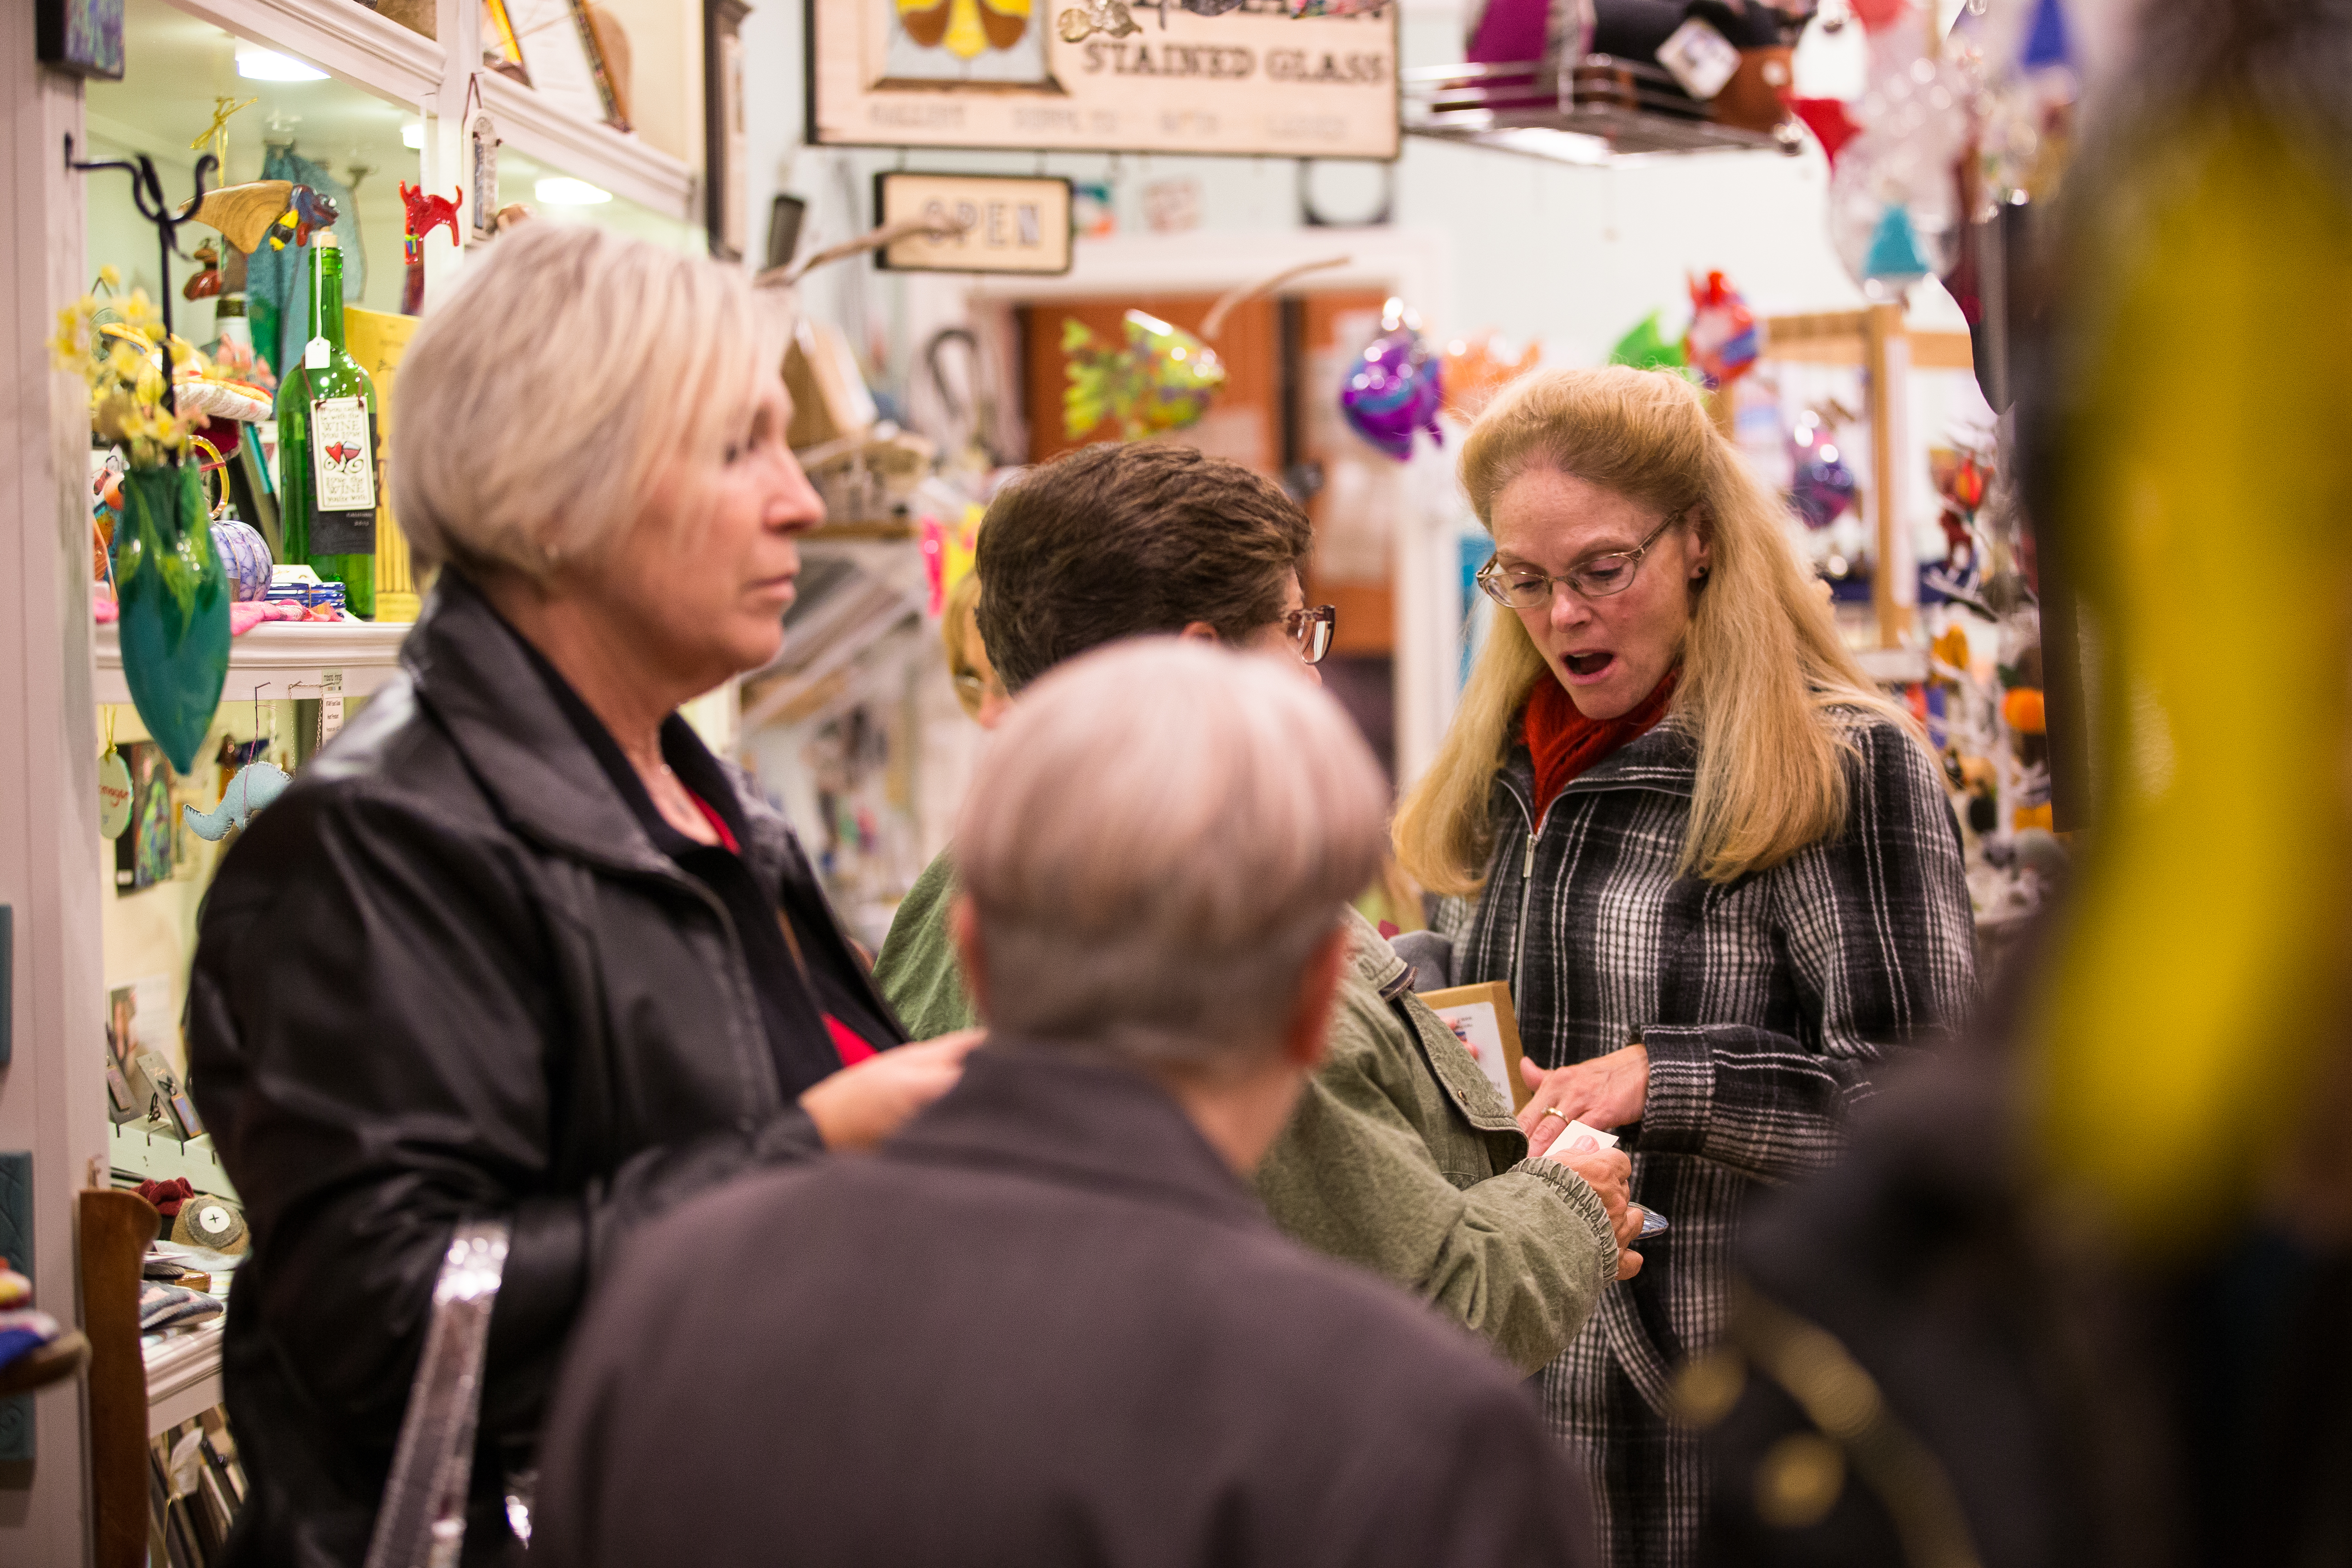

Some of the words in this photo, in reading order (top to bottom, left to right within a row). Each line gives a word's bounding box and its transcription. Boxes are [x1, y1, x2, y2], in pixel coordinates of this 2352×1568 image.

[1081, 42, 1256, 78] STAINED
[1265, 48, 1385, 85] GLASS
[922, 198, 1041, 247] OPEN
[321, 420, 361, 431] WINE
[328, 484, 365, 495] WINE
